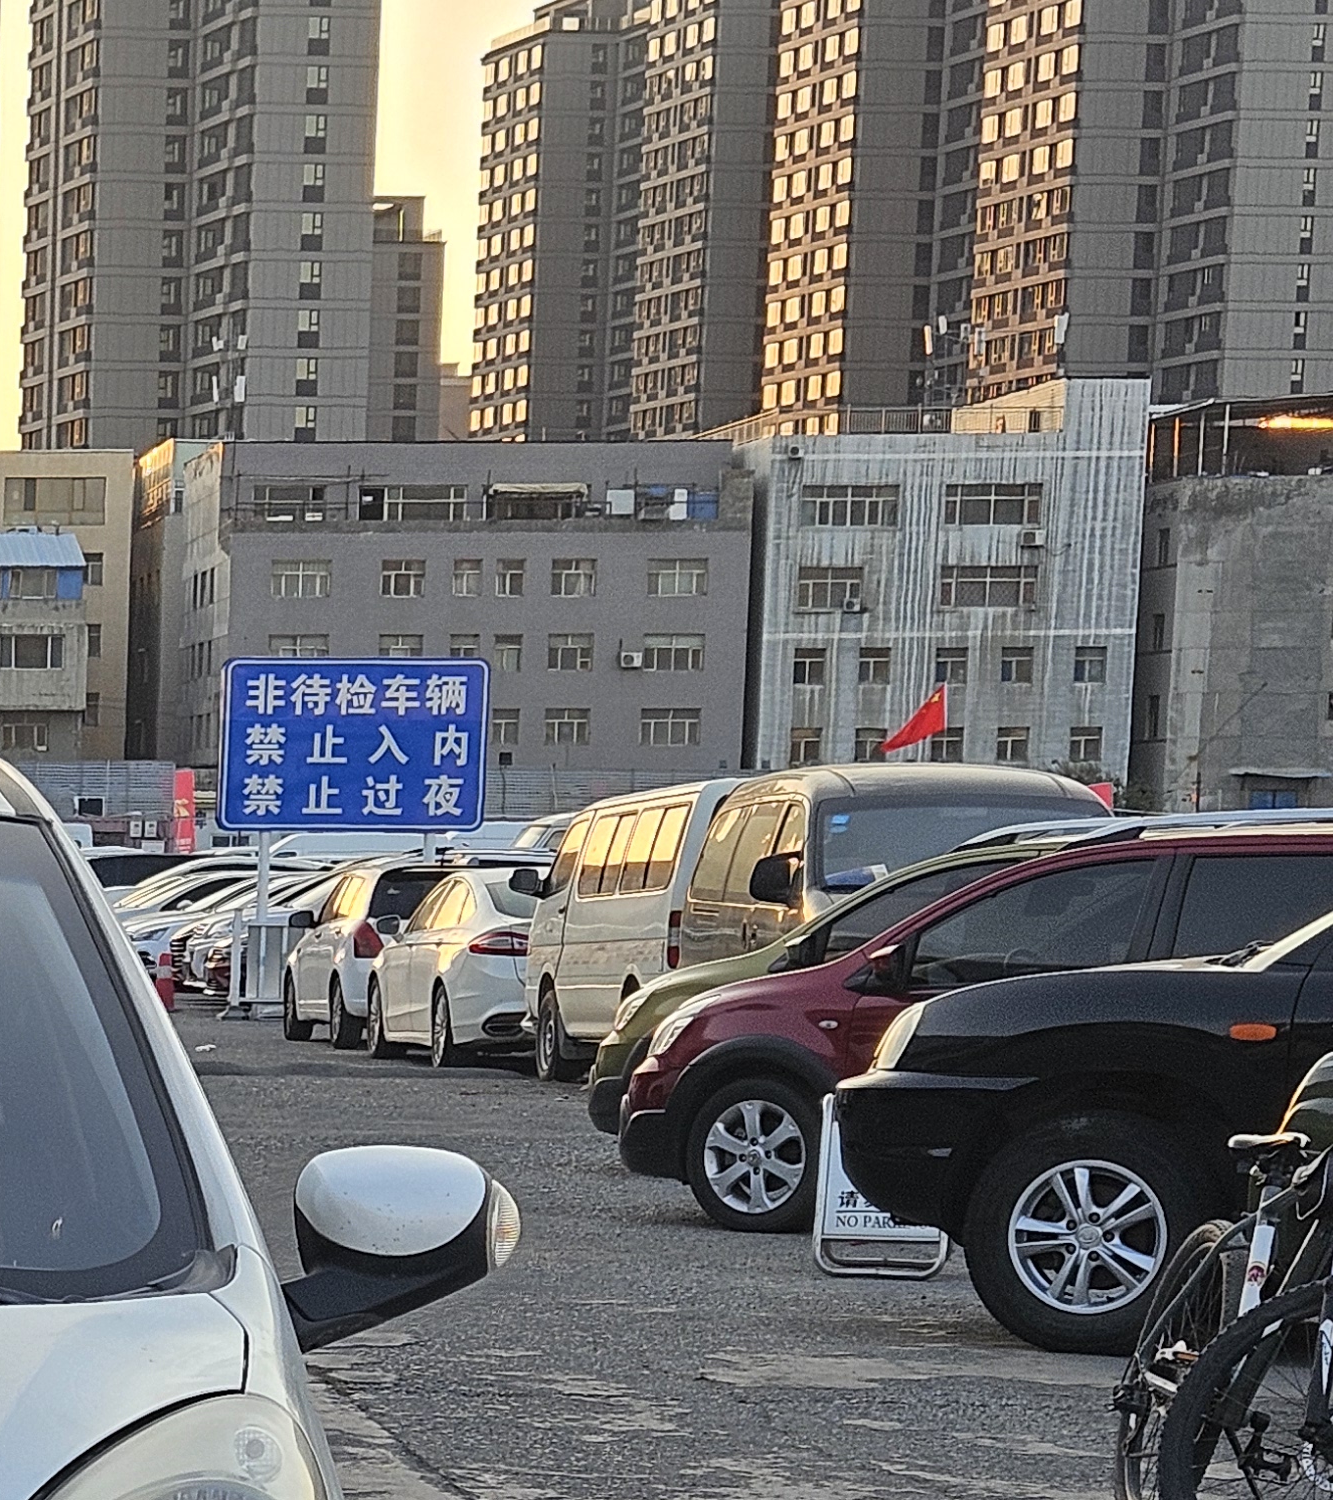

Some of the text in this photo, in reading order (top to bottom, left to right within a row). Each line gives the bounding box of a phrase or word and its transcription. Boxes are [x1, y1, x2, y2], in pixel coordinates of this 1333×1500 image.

[246, 673, 468, 717] 非待检车辆
[244, 723, 469, 767] 禁止入内
[241, 774, 465, 817] 禁止过夜
[835, 1215, 859, 1228] NO
